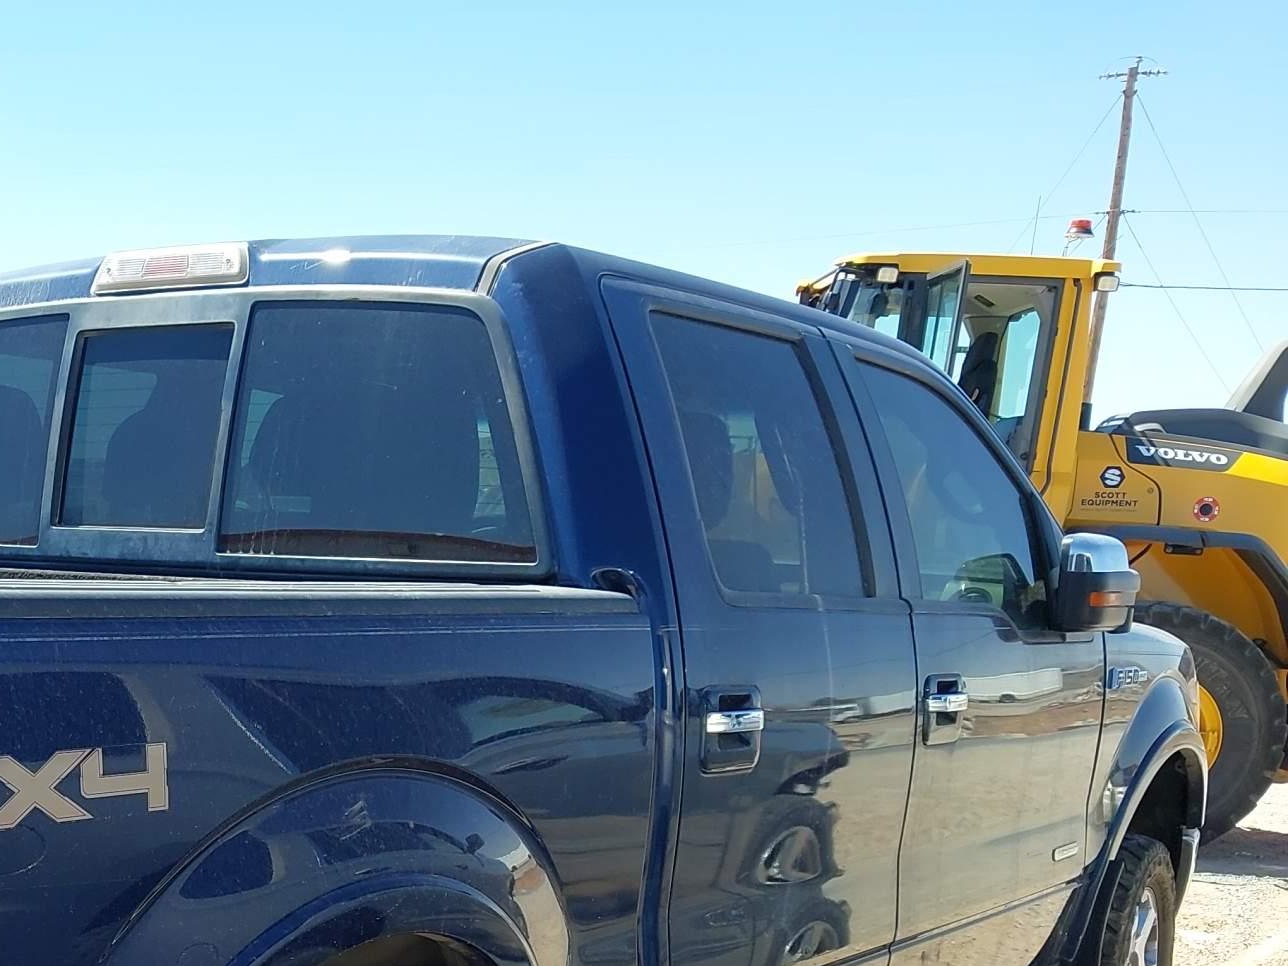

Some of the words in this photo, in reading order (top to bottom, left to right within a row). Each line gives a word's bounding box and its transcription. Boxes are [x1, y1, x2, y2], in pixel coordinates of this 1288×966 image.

[1135, 445, 1229, 465] VOLVO
[1094, 491, 1128, 499] SCOTT
[1080, 499, 1139, 507] EQUIPMENT
